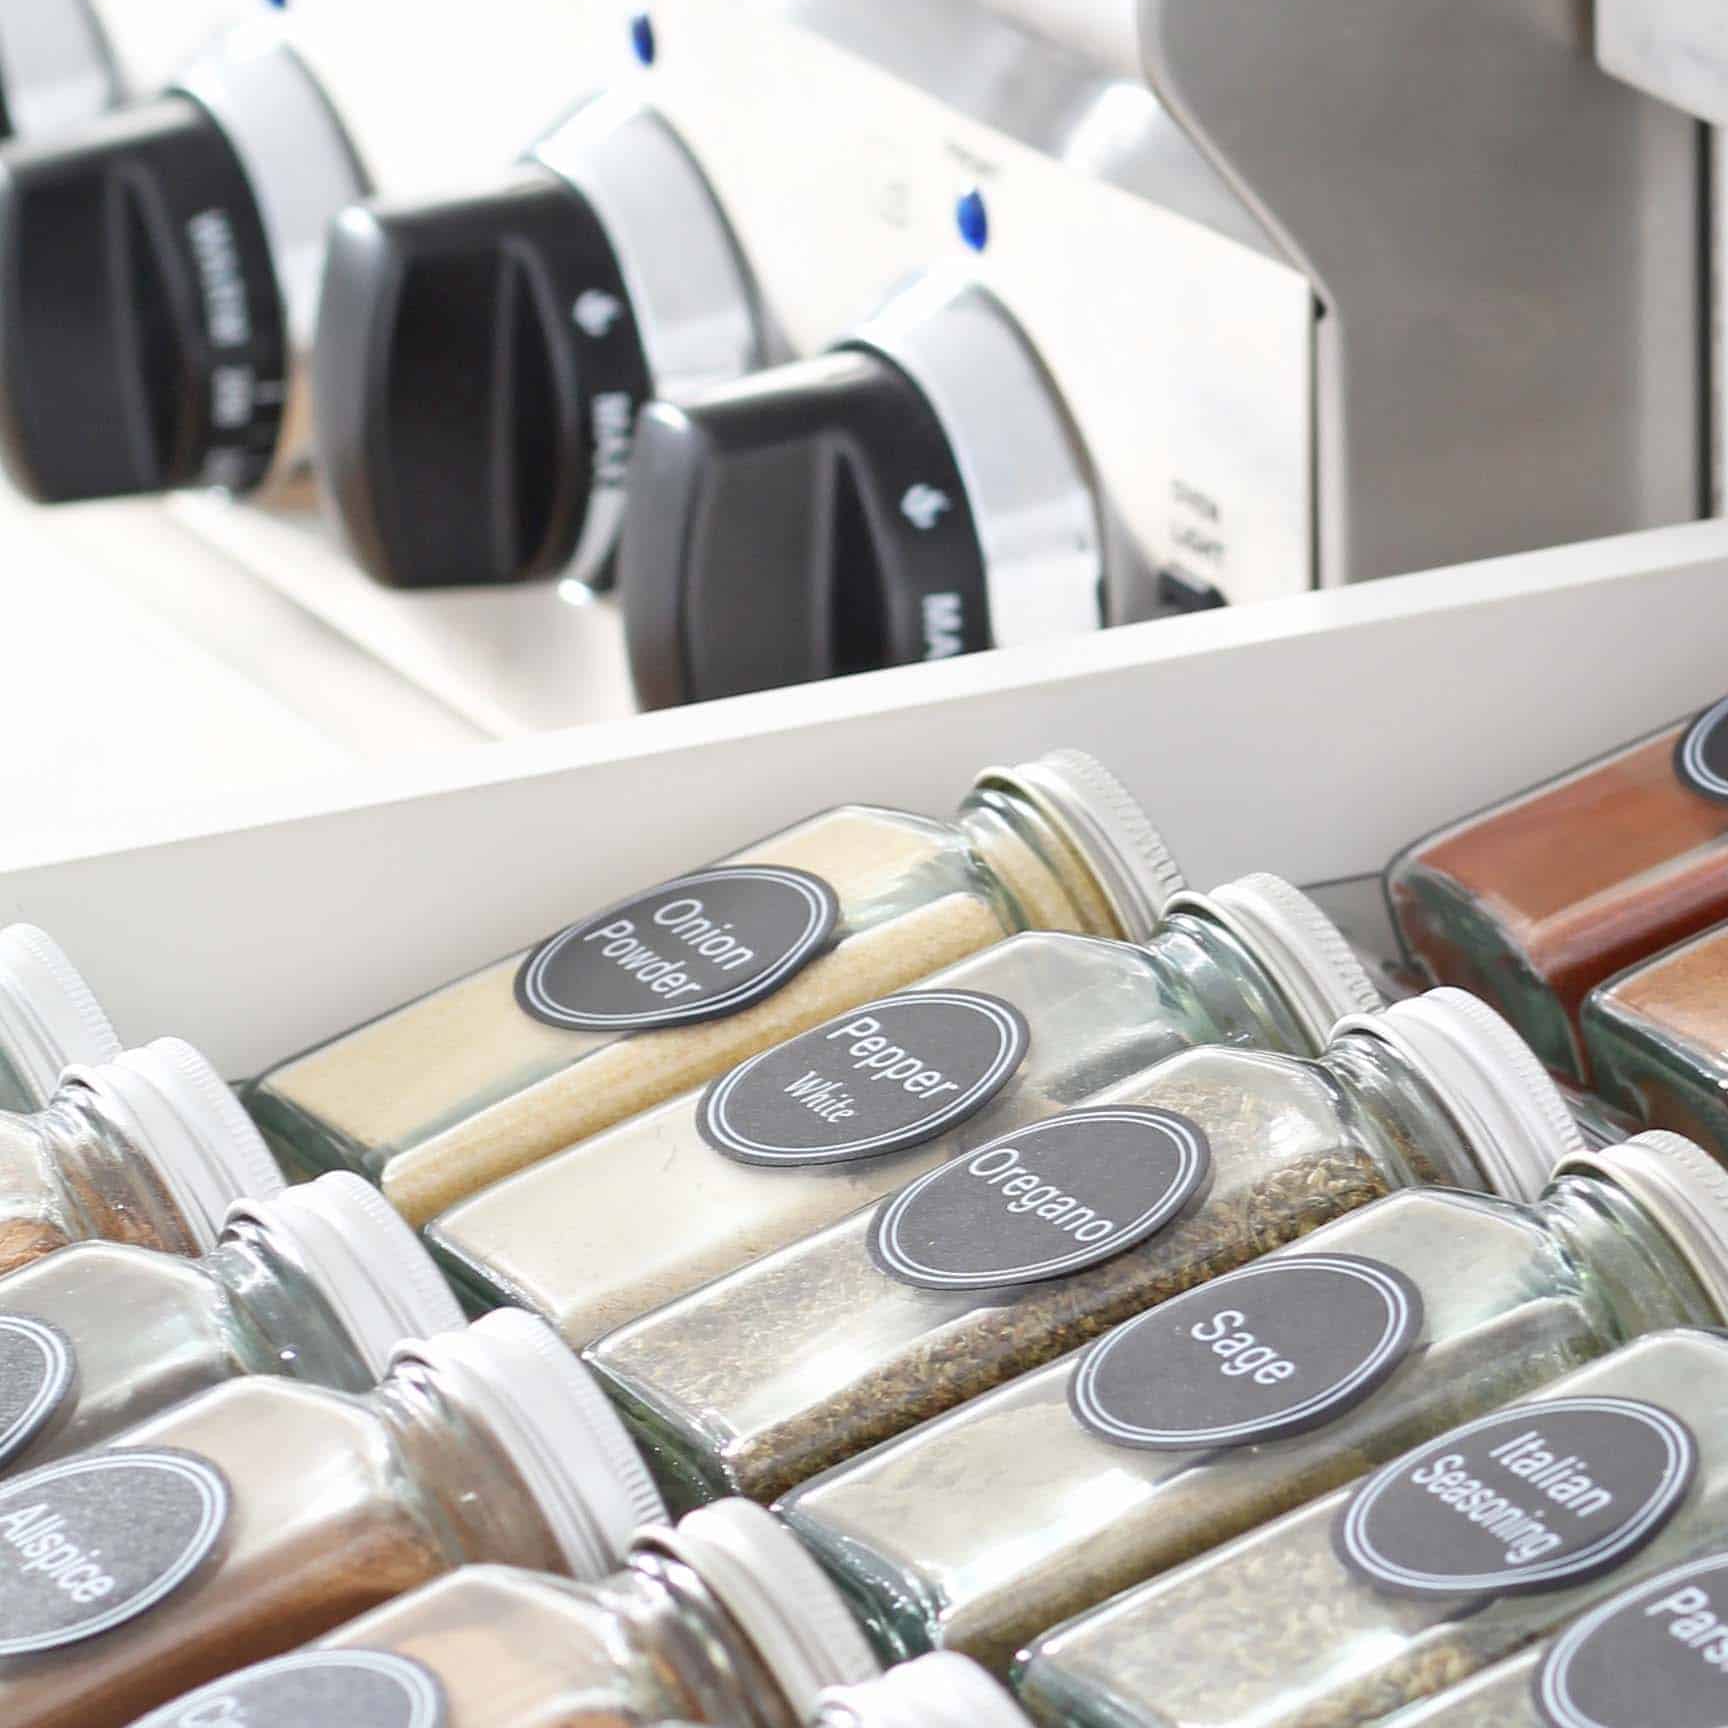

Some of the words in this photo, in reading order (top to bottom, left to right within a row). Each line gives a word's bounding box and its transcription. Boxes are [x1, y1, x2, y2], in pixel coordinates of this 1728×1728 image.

[583, 919, 703, 999] Powder
[653, 898, 755, 970] Onion
[783, 1070, 857, 1123] White
[826, 1016, 958, 1099] Pepper
[968, 1147, 1115, 1242] Oregano
[1190, 1309, 1296, 1385] Sage
[1411, 1453, 1563, 1564] Seasoning
[1488, 1430, 1613, 1517] Italian
[0, 1503, 116, 1603] Allspice
